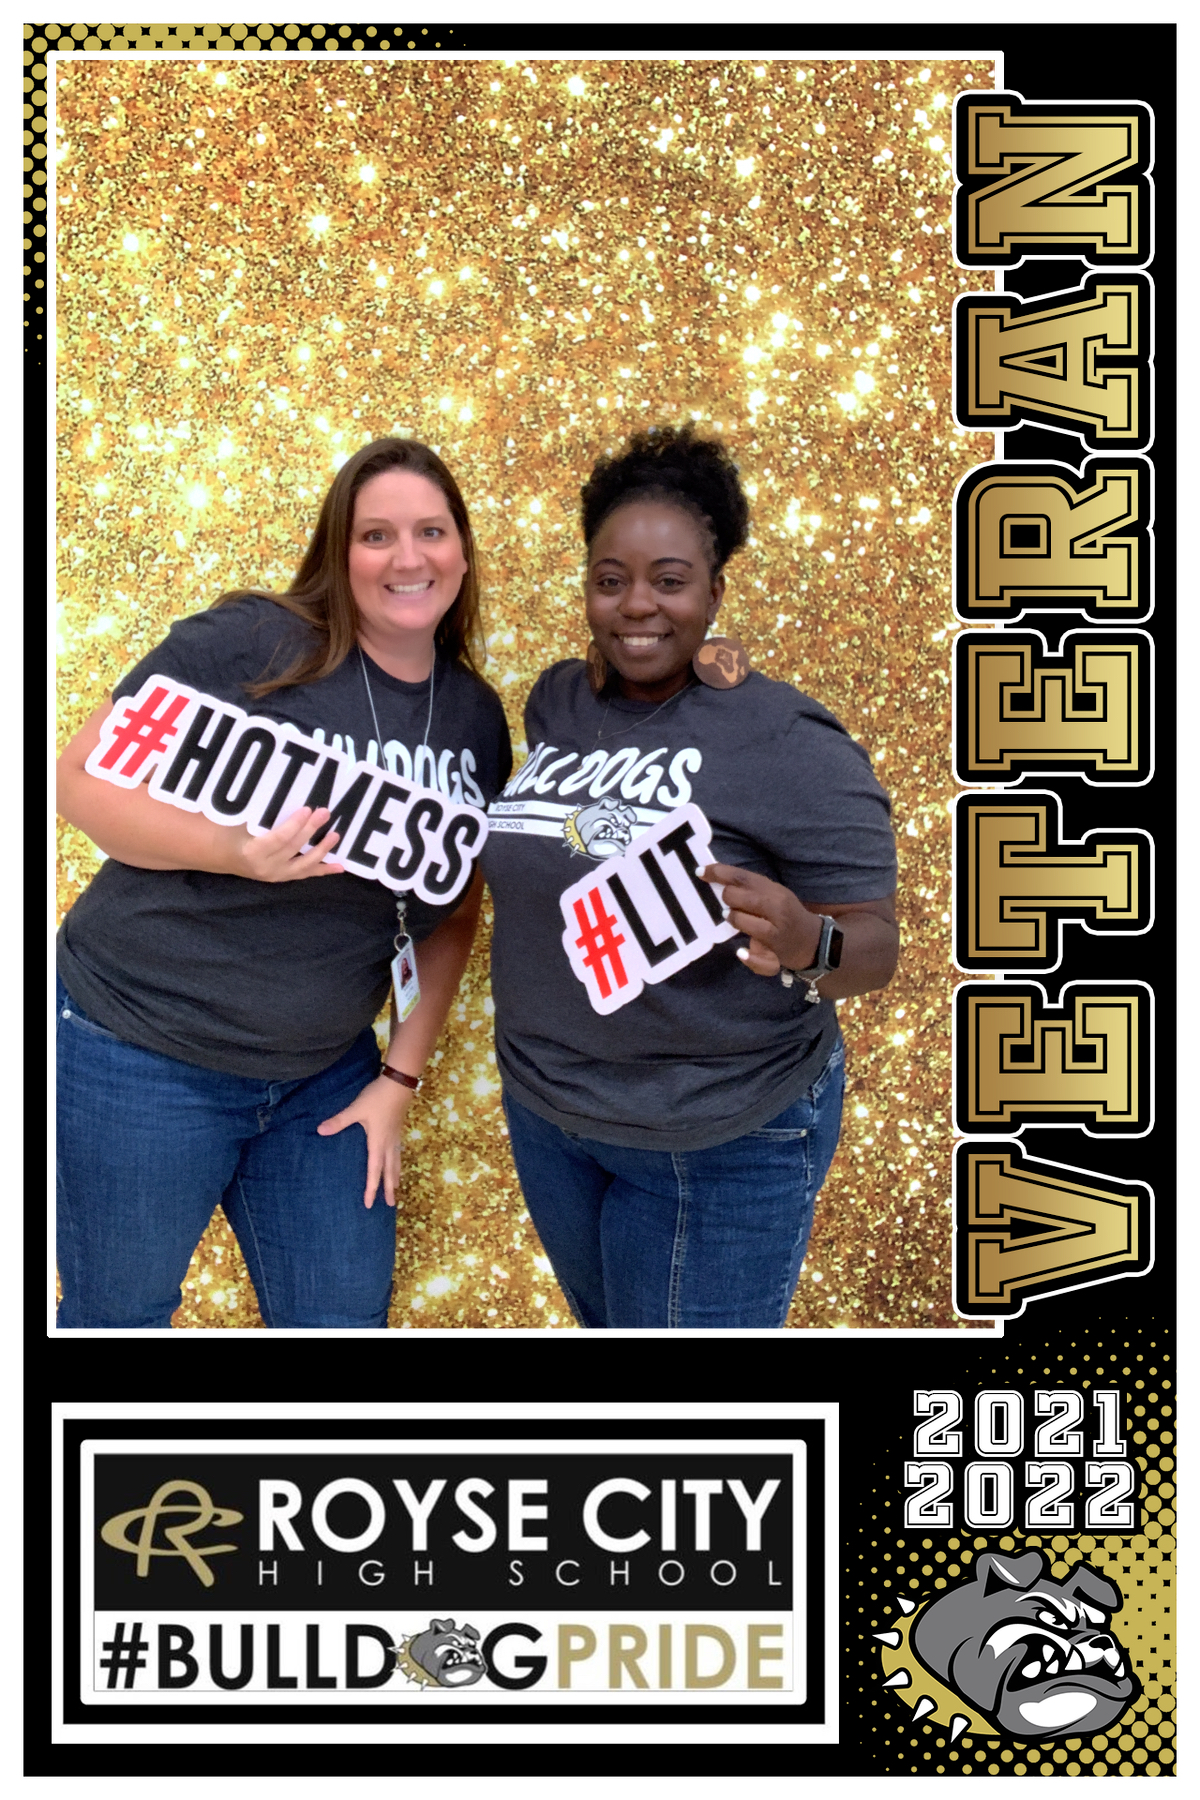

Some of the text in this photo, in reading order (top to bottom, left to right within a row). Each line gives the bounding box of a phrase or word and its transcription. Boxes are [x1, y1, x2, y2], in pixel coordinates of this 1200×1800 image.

[98, 686, 480, 895] #HOTMESS
[497, 821, 525, 830] SCHOOL
[572, 820, 726, 1000] #LIT
